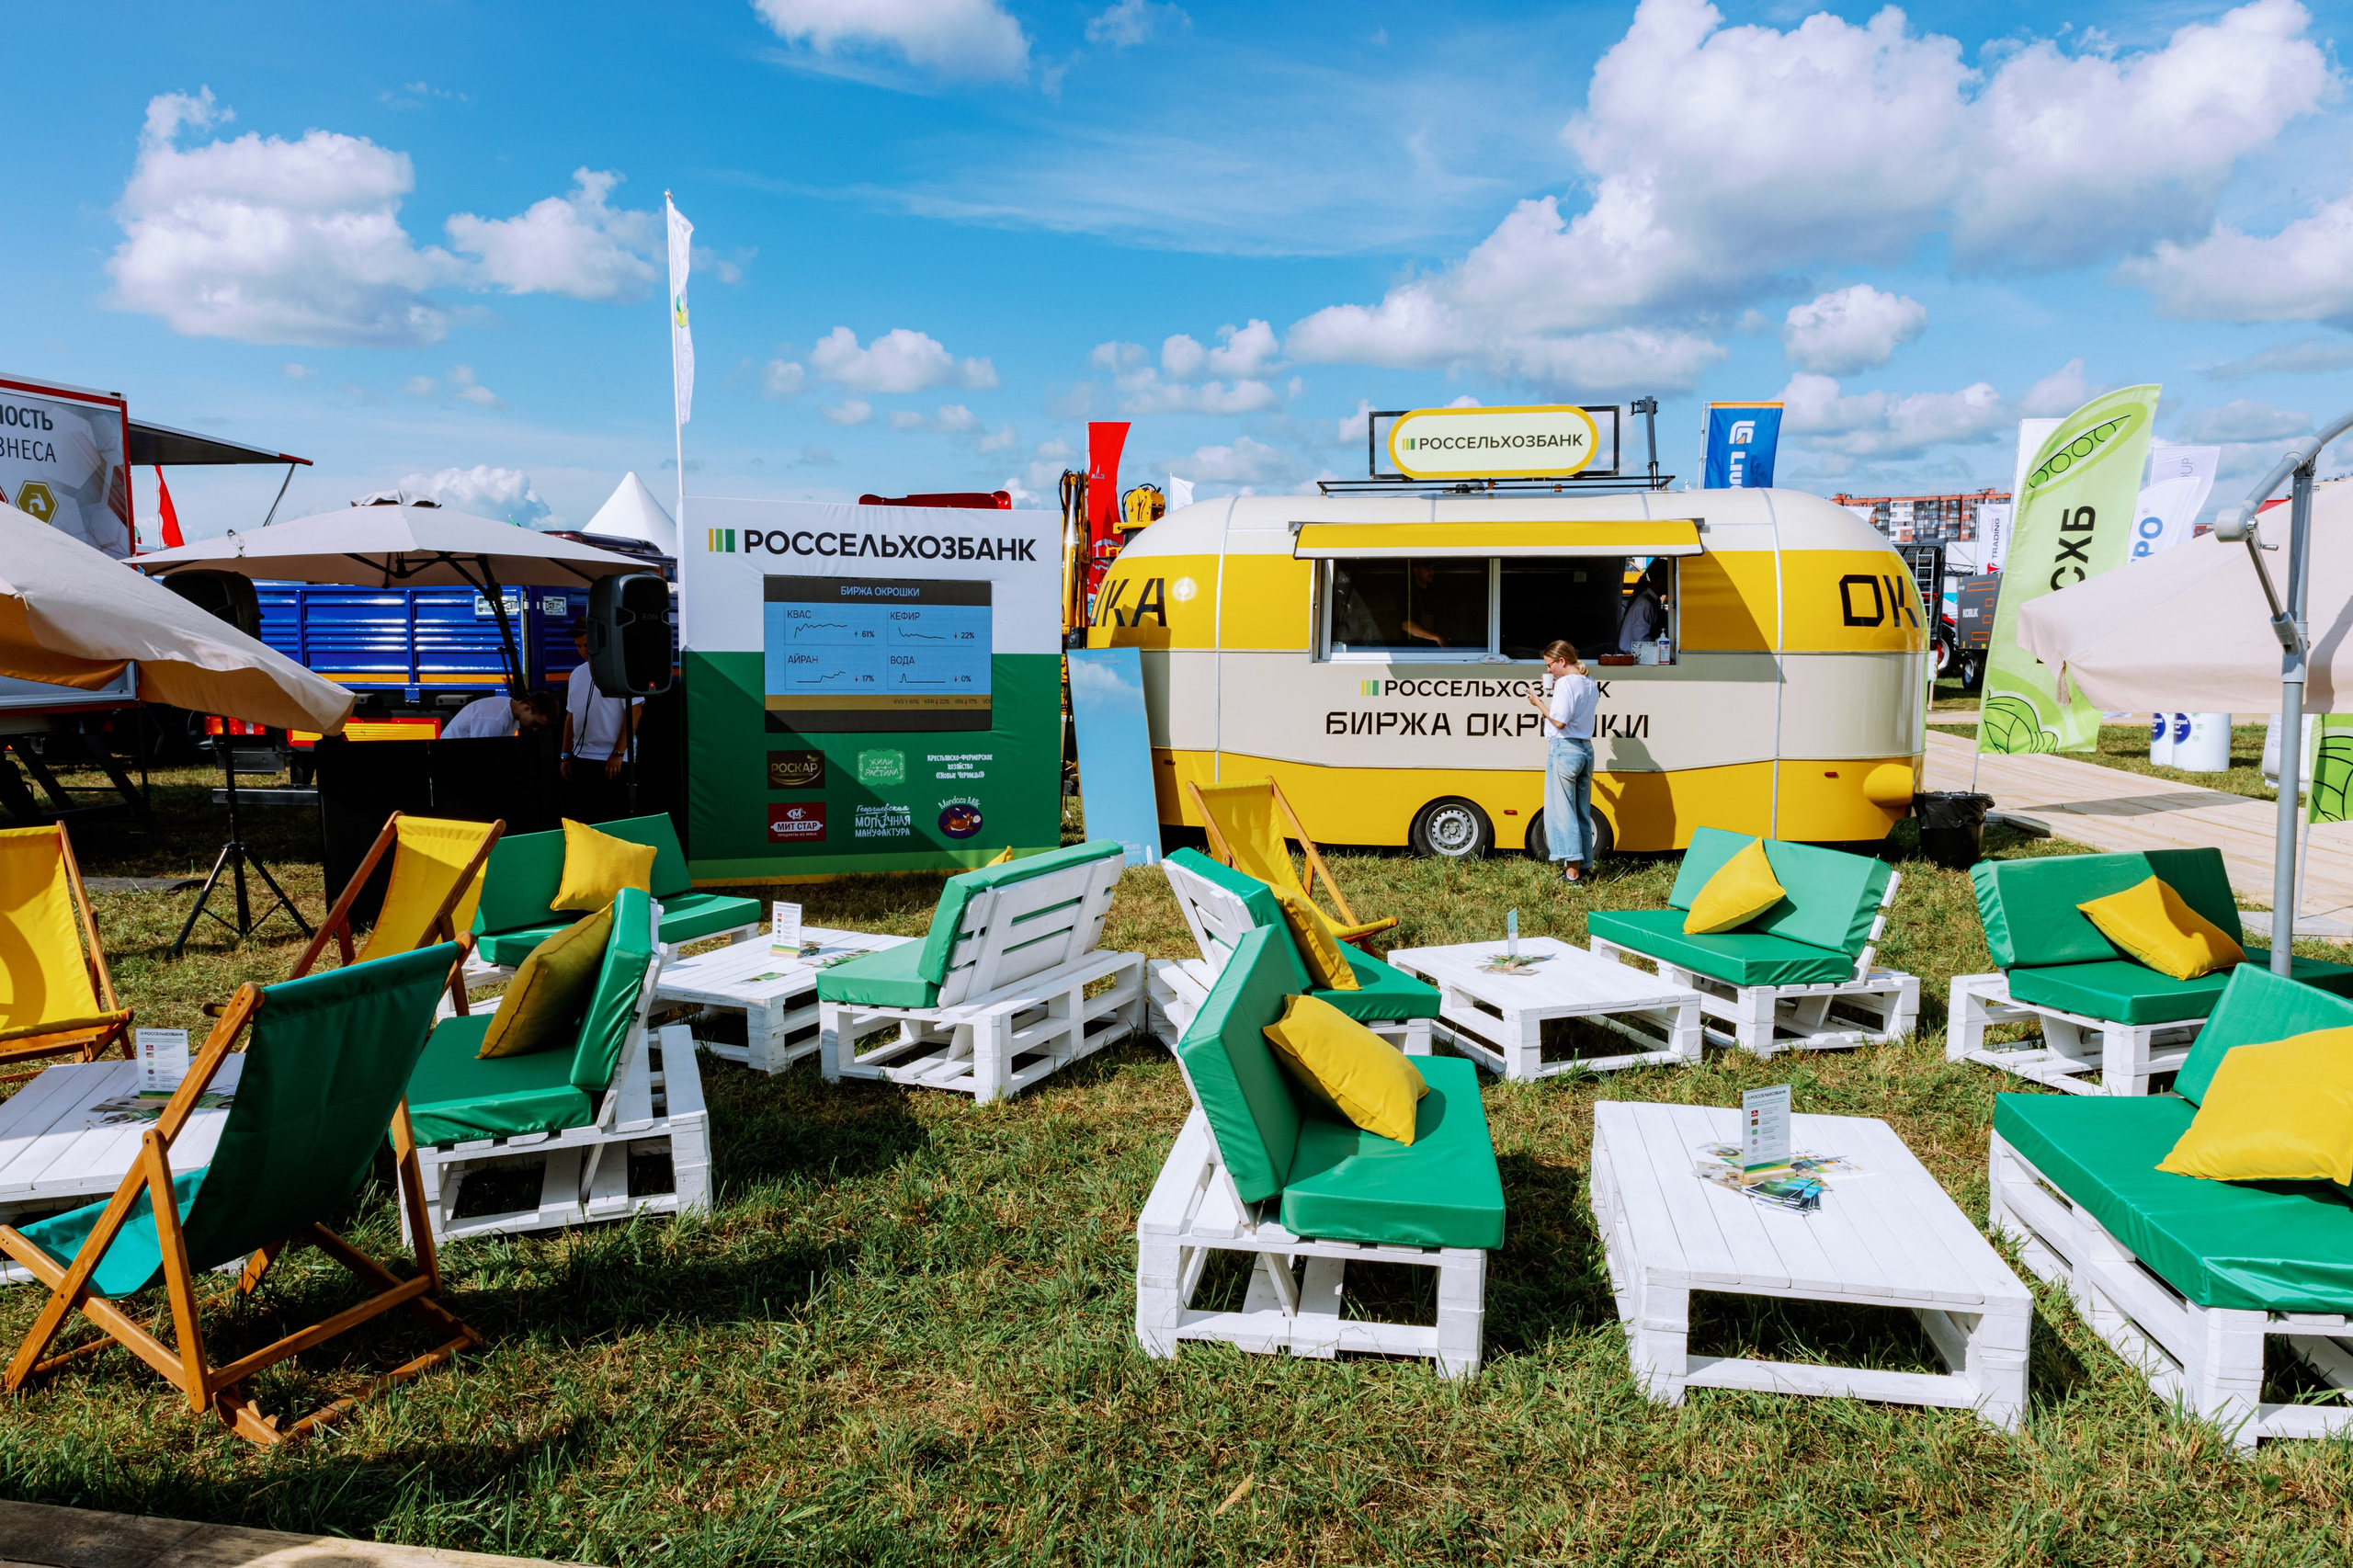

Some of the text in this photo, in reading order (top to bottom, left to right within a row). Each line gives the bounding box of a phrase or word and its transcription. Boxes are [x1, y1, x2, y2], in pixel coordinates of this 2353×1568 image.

[1419, 433, 1583, 450] РОССЕЛЬХОЗБАНК
[1729, 451, 1745, 489] LIU
[2179, 458, 2194, 477] UP
[1991, 517, 2000, 559] TRADING
[745, 529, 1037, 562] РОССЕЛЬХОЗБАНК
[840, 585, 920, 597] БИРЖА ОКРОШКИ
[787, 609, 812, 619] КВАС
[890, 611, 920, 620] КЕФИР
[788, 654, 818, 664] АЙРАН
[890, 655, 915, 665] ВОДА
[861, 675, 874, 683] 17%
[1384, 679, 1611, 699] РОССЕЛЬХОЗК
[1326, 711, 1649, 739] БИРЖА ОКРКИ
[771, 762, 818, 773] РОСКАР
[938, 795, 967, 810] Mendoza
[777, 822, 818, 831] МИТ СТАР
[855, 827, 911, 837] МАНУФАКТУРА
